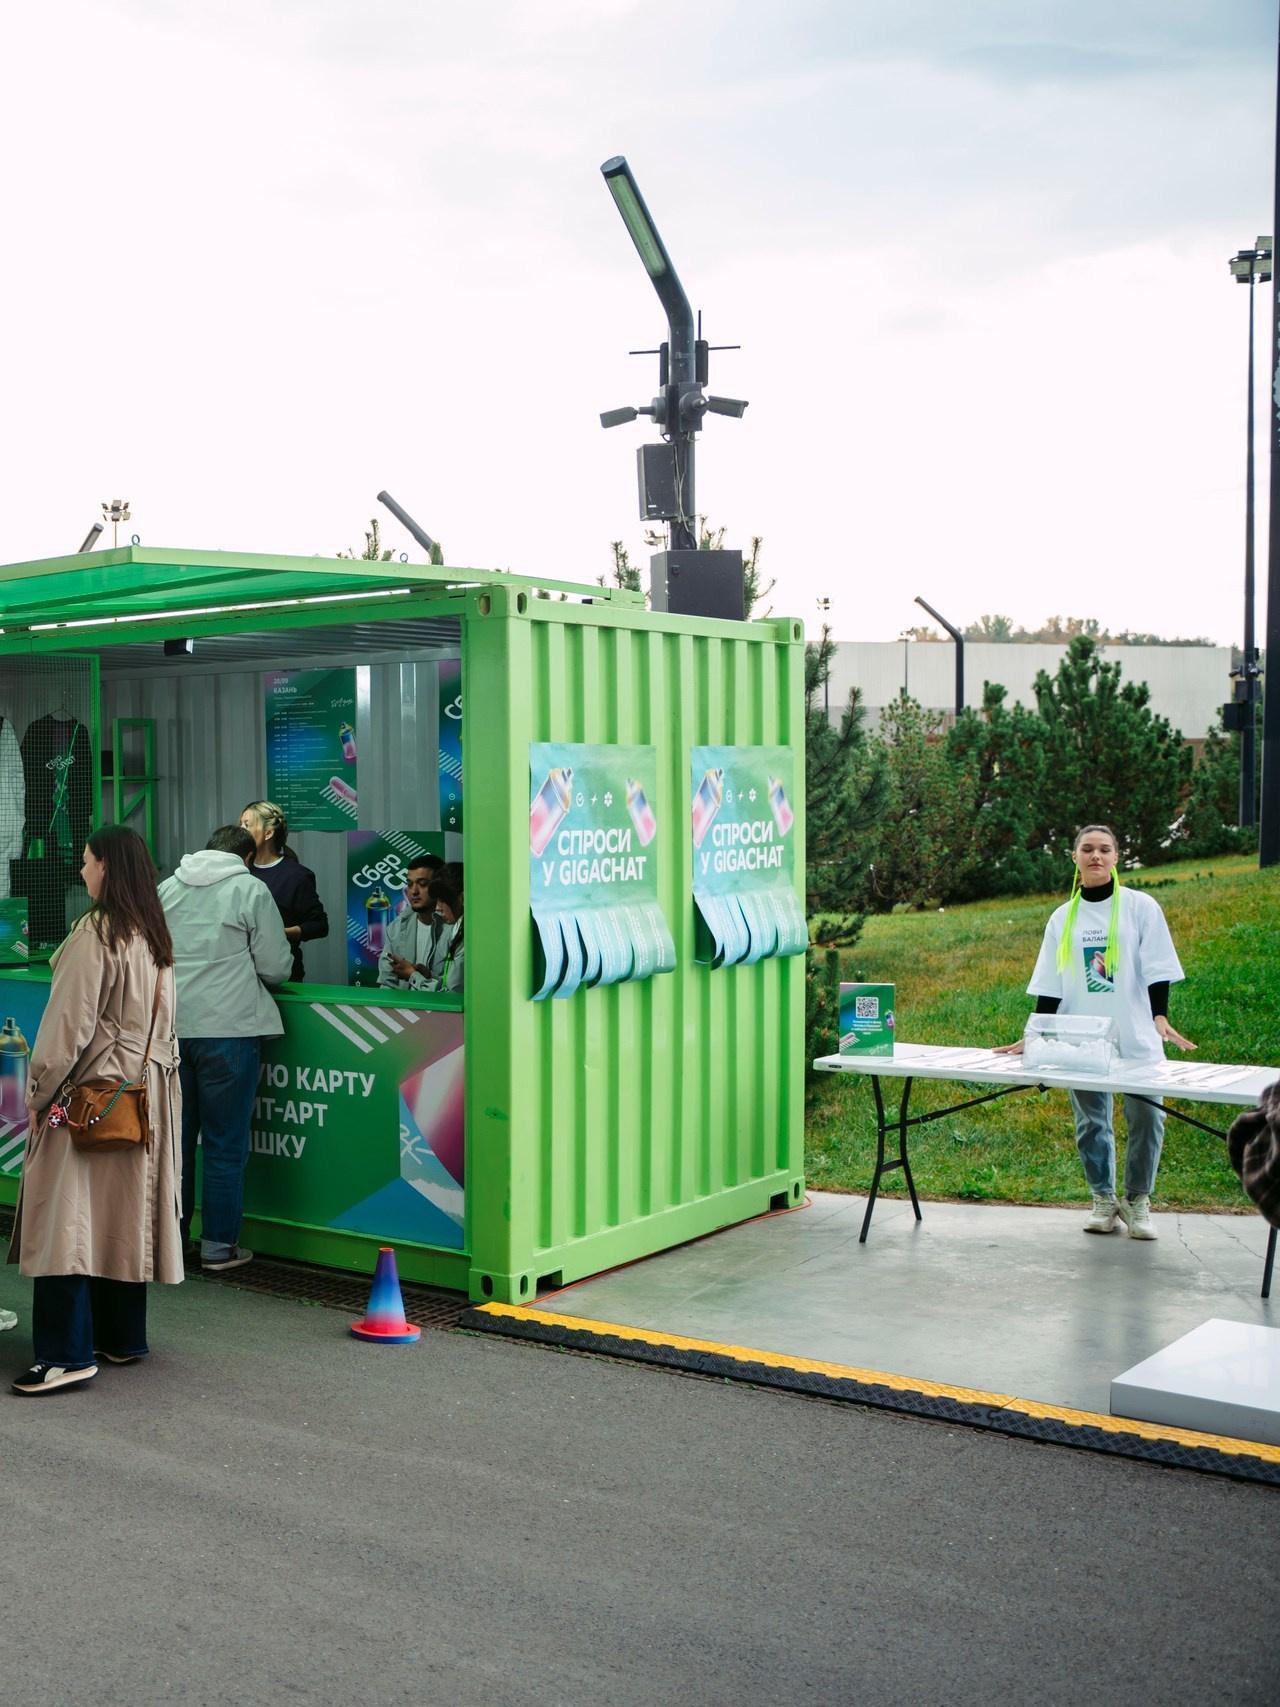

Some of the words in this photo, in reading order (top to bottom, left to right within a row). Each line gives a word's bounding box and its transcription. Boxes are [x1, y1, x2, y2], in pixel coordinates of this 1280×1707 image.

[273, 686, 298, 694] КАЗАНЬ
[557, 828, 631, 856] СПРОСИ
[712, 821, 773, 847] СПРОСИ
[352, 853, 401, 888] Сбер
[542, 861, 555, 887] У
[560, 856, 647, 886] GIGACHAT
[700, 851, 710, 875] У
[714, 845, 784, 874] GIGACHAT
[296, 1066, 376, 1097] КАРТУ
